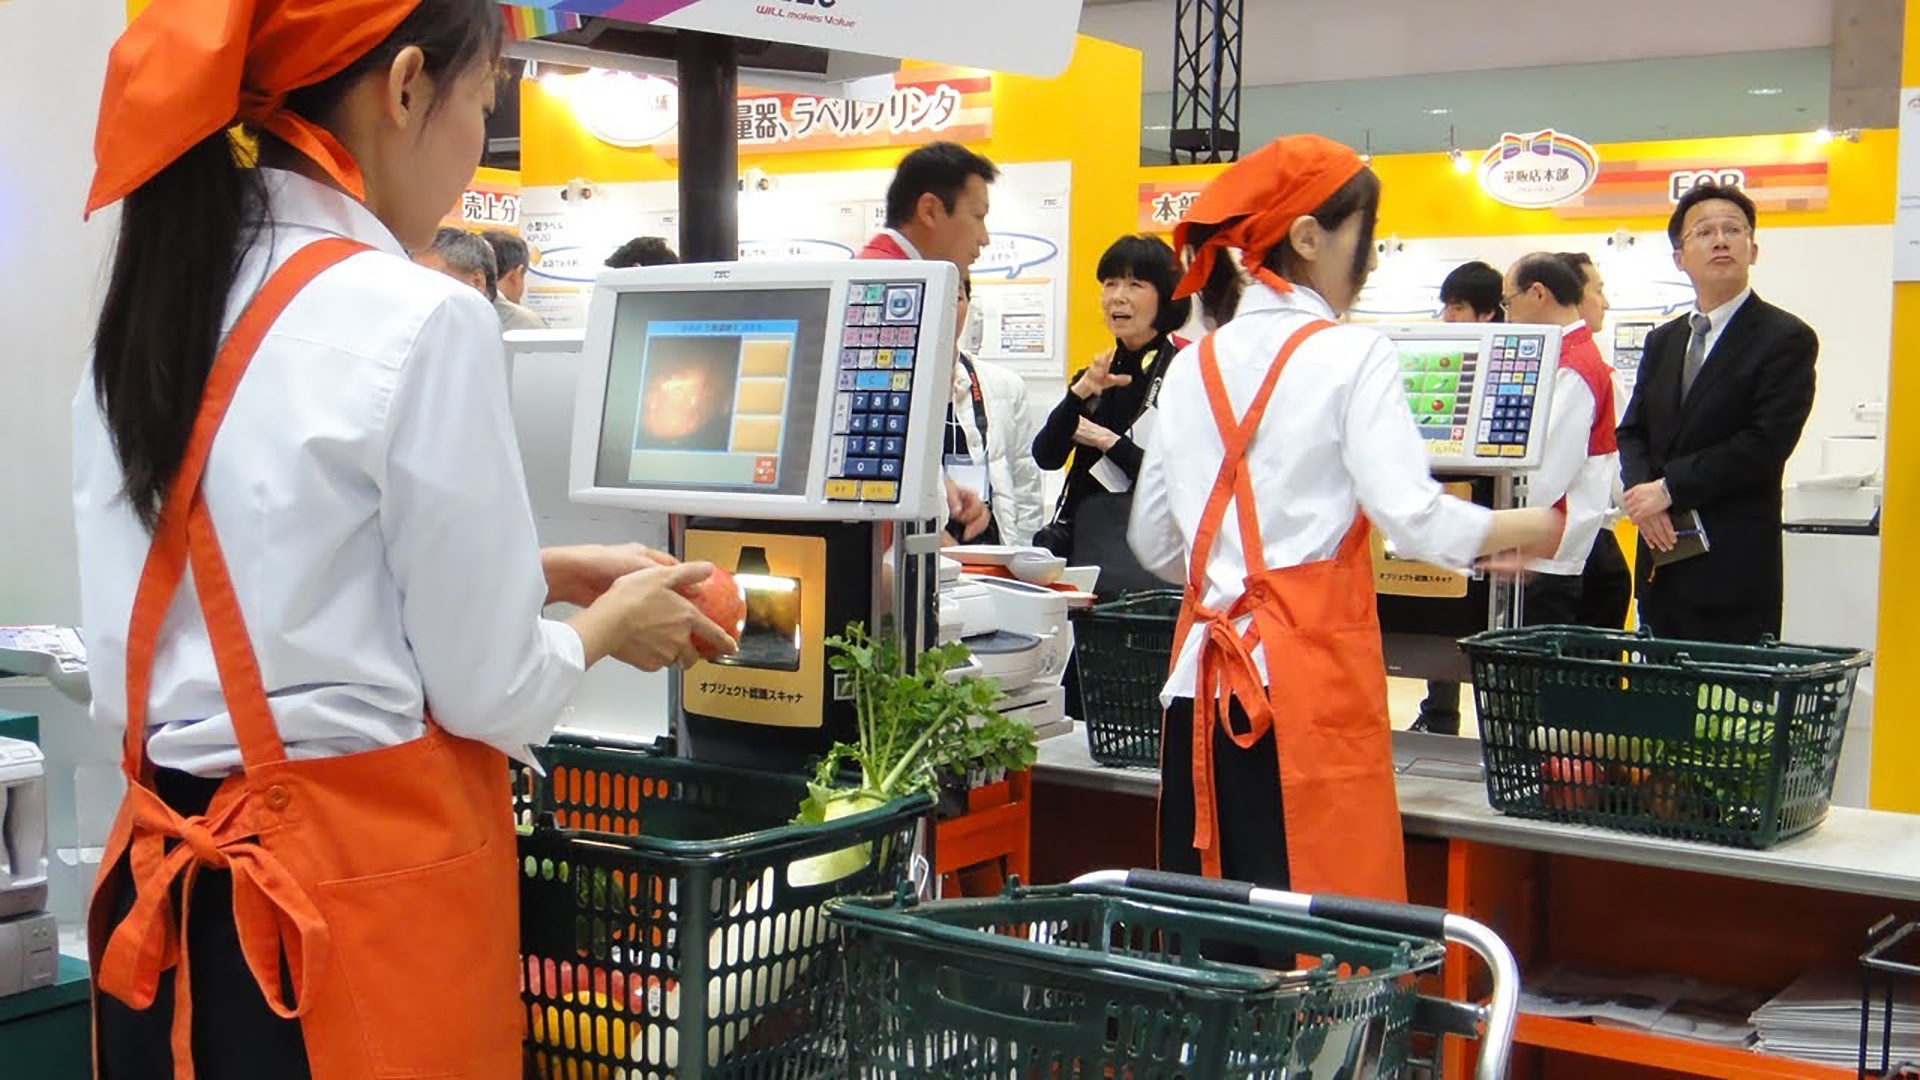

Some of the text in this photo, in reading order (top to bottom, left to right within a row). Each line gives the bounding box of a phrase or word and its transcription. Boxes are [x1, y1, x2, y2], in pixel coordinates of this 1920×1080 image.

[787, 11, 822, 23] makes
[824, 16, 856, 28] Value
[464, 194, 516, 222] 売上分
[857, 396, 900, 406] 7 8 9
[853, 418, 897, 429] 4 5 6
[869, 441, 877, 451] 2
[887, 441, 894, 451] 3
[857, 462, 865, 471] 0
[699, 681, 804, 704] オブジェクト認識スキャナ
